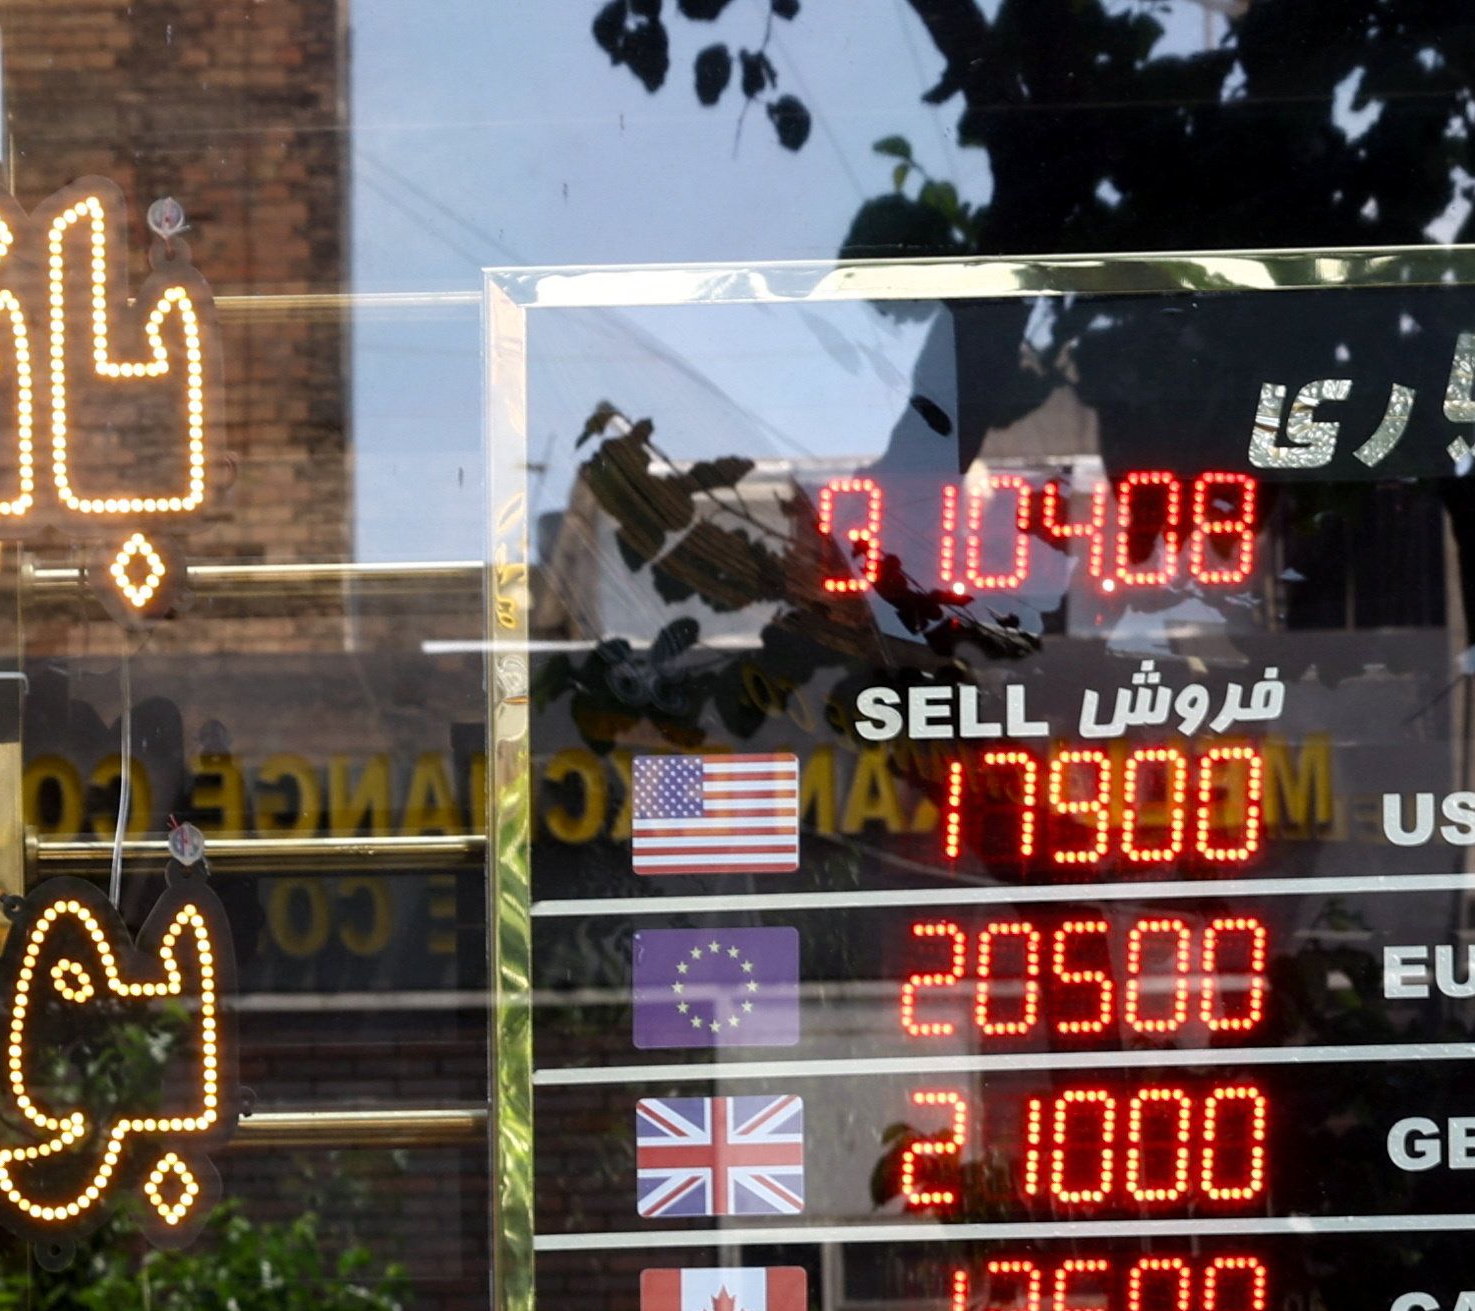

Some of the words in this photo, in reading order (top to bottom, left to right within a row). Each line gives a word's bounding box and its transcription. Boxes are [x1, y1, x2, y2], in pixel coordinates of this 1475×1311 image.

[855, 685, 1049, 741] SELL
[1079, 658, 1285, 740] فروش
[944, 745, 1264, 866] 17900
[899, 916, 1268, 1039] 20500
[900, 1084, 1268, 1207] 21000
